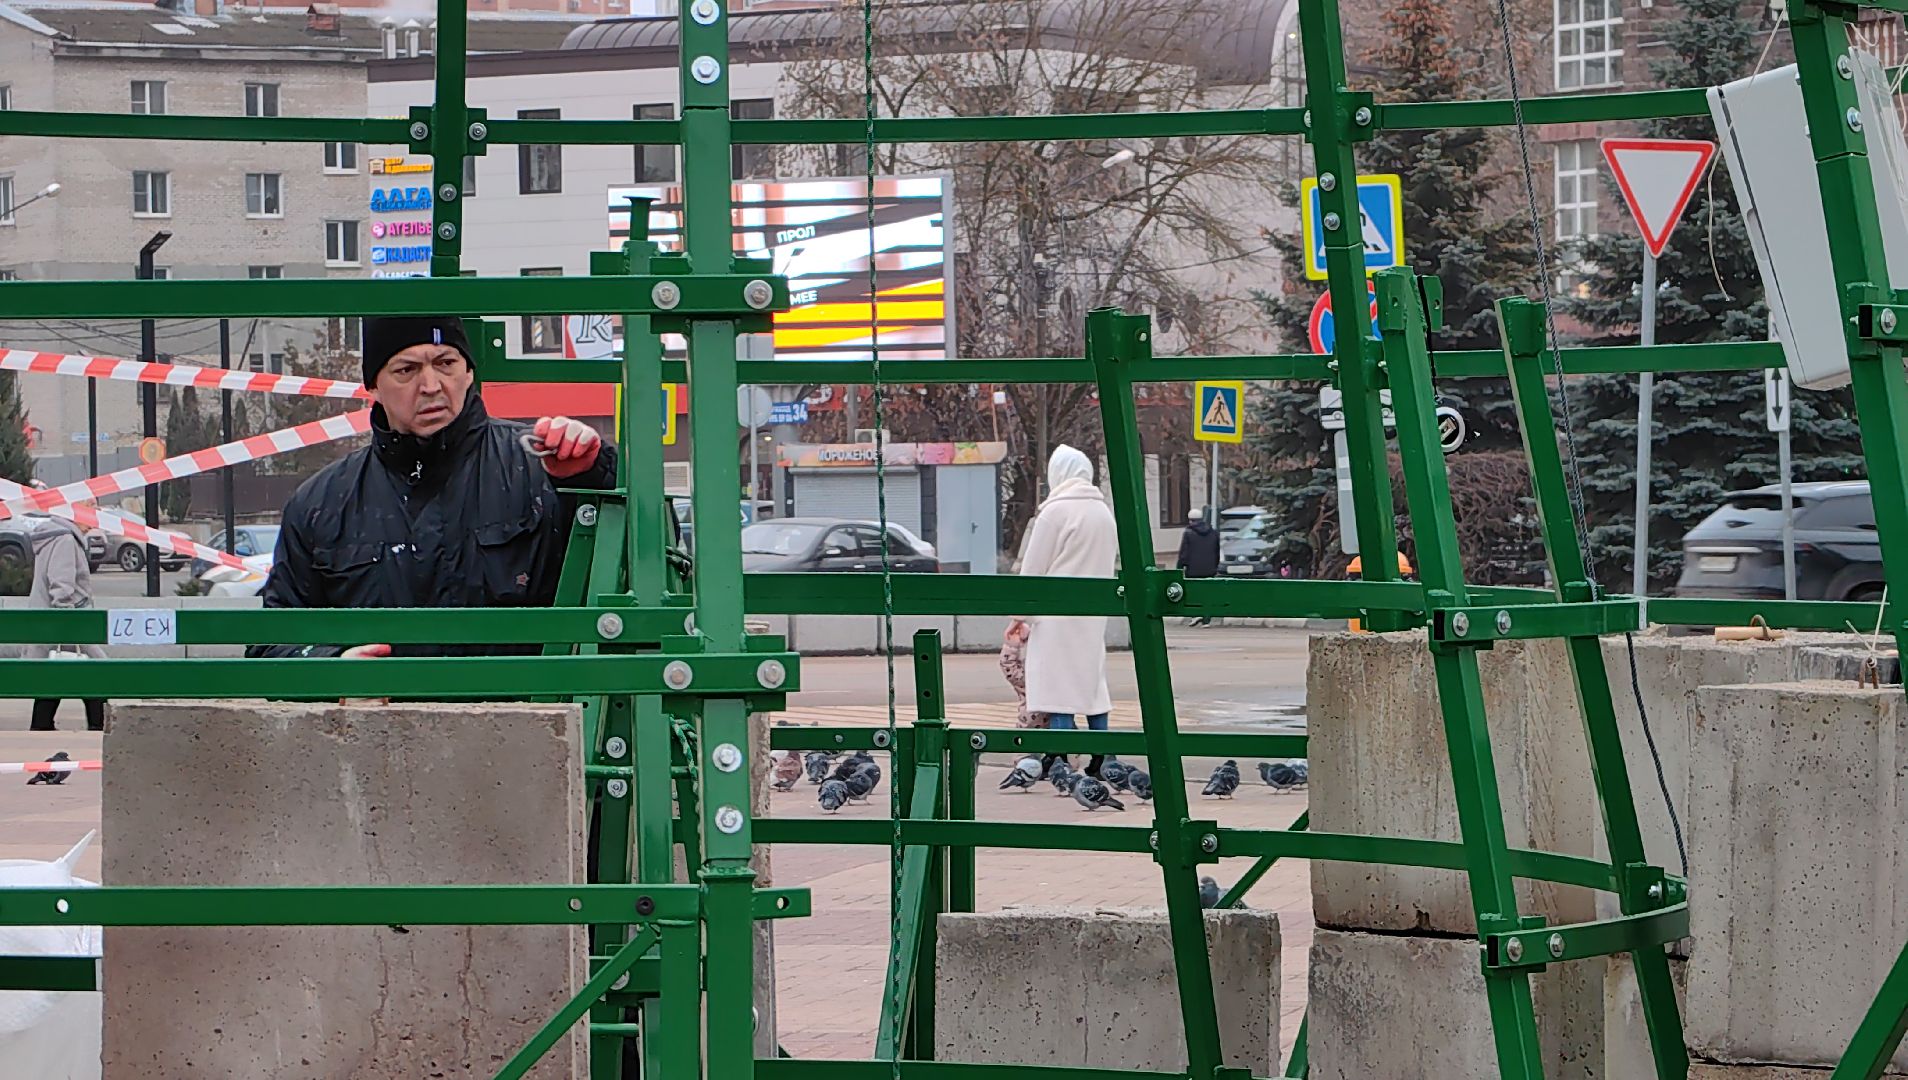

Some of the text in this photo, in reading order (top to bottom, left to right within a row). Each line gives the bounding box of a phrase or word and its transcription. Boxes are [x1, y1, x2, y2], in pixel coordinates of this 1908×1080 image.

[371, 186, 432, 202] АЛГА
[388, 222, 432, 236] АТЕЛЬЕ
[776, 225, 816, 244] ПРОЛ
[792, 403, 808, 422] 34
[113, 618, 134, 637] 27
